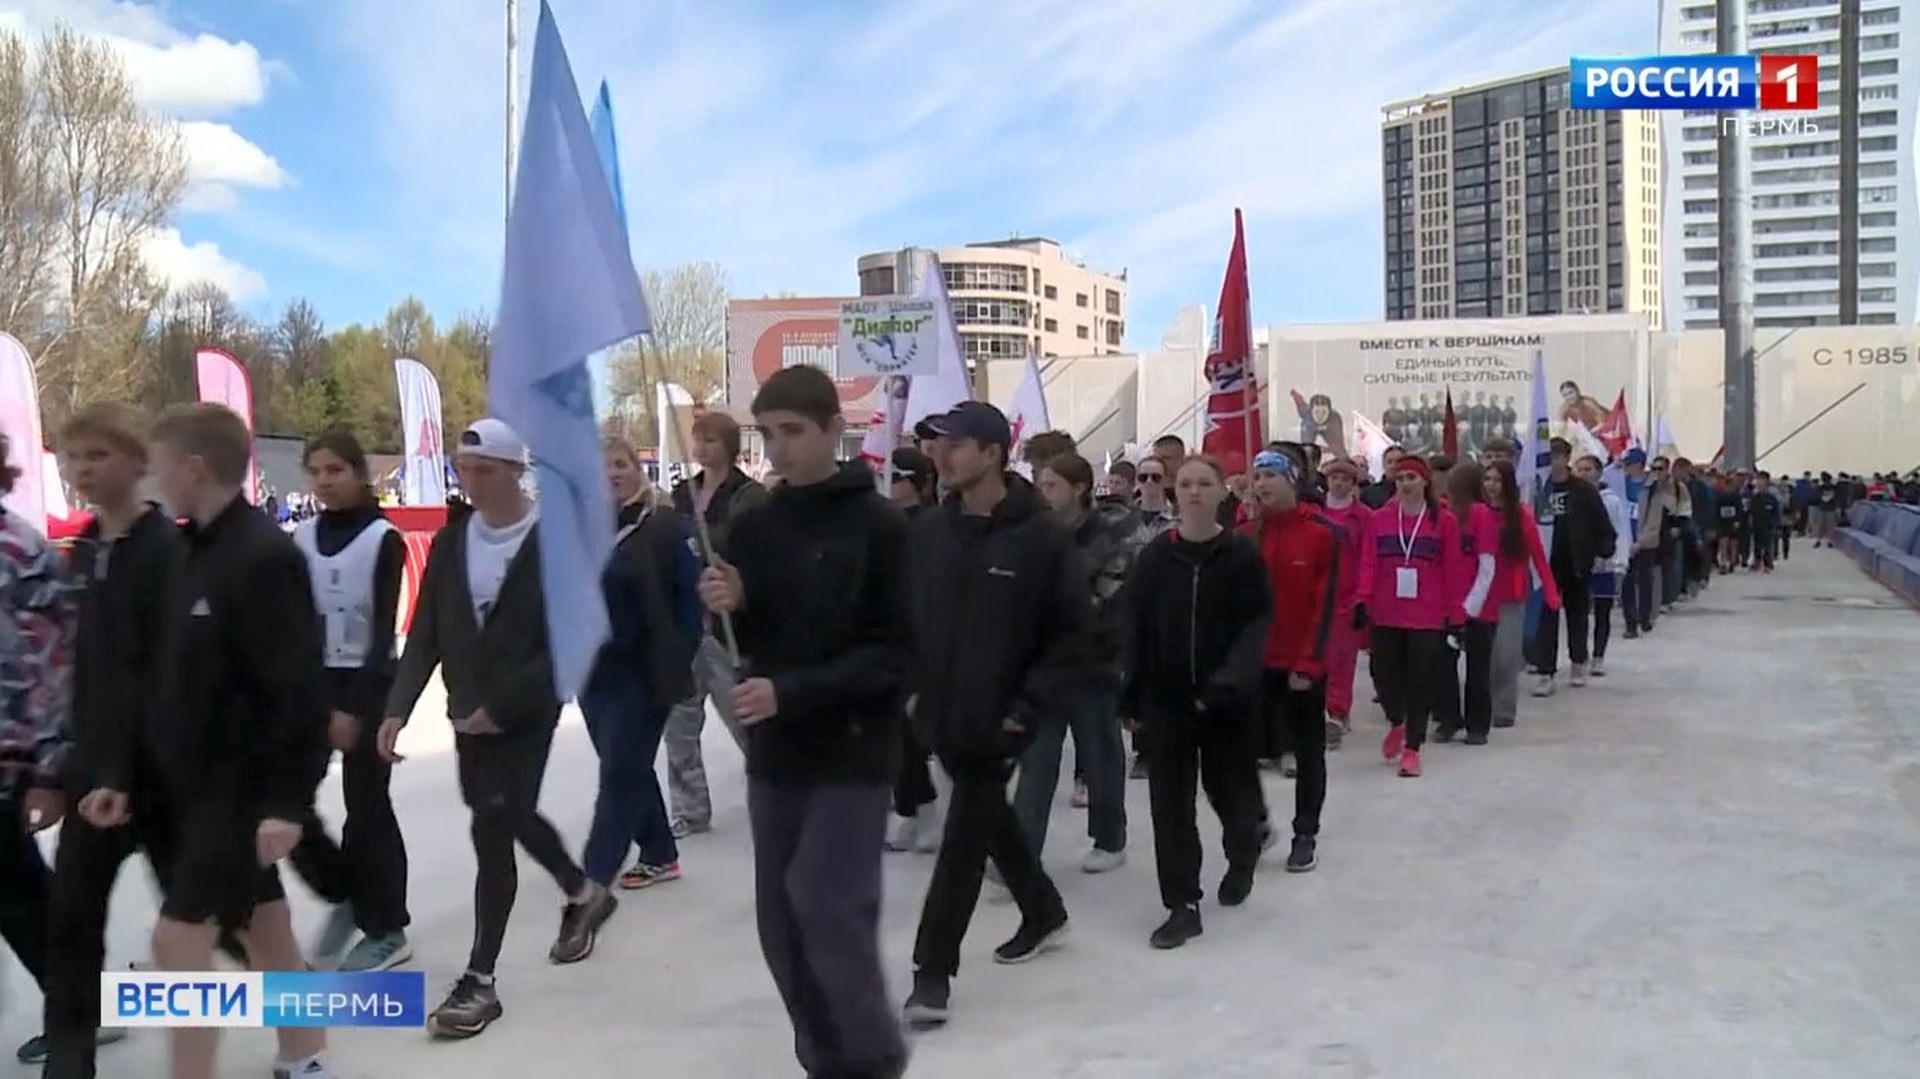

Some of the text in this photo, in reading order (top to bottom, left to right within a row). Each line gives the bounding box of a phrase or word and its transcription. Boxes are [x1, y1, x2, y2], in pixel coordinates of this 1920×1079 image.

[1359, 335, 1546, 351] ВМЕСТЕ К ВЕРШИНАМ:
[1395, 355, 1461, 370] ЕДИНЫЙ
[1813, 348, 1833, 366] С
[1843, 347, 1908, 365] 1985
[1363, 371, 1438, 385] СИЛЬНЫЕ
